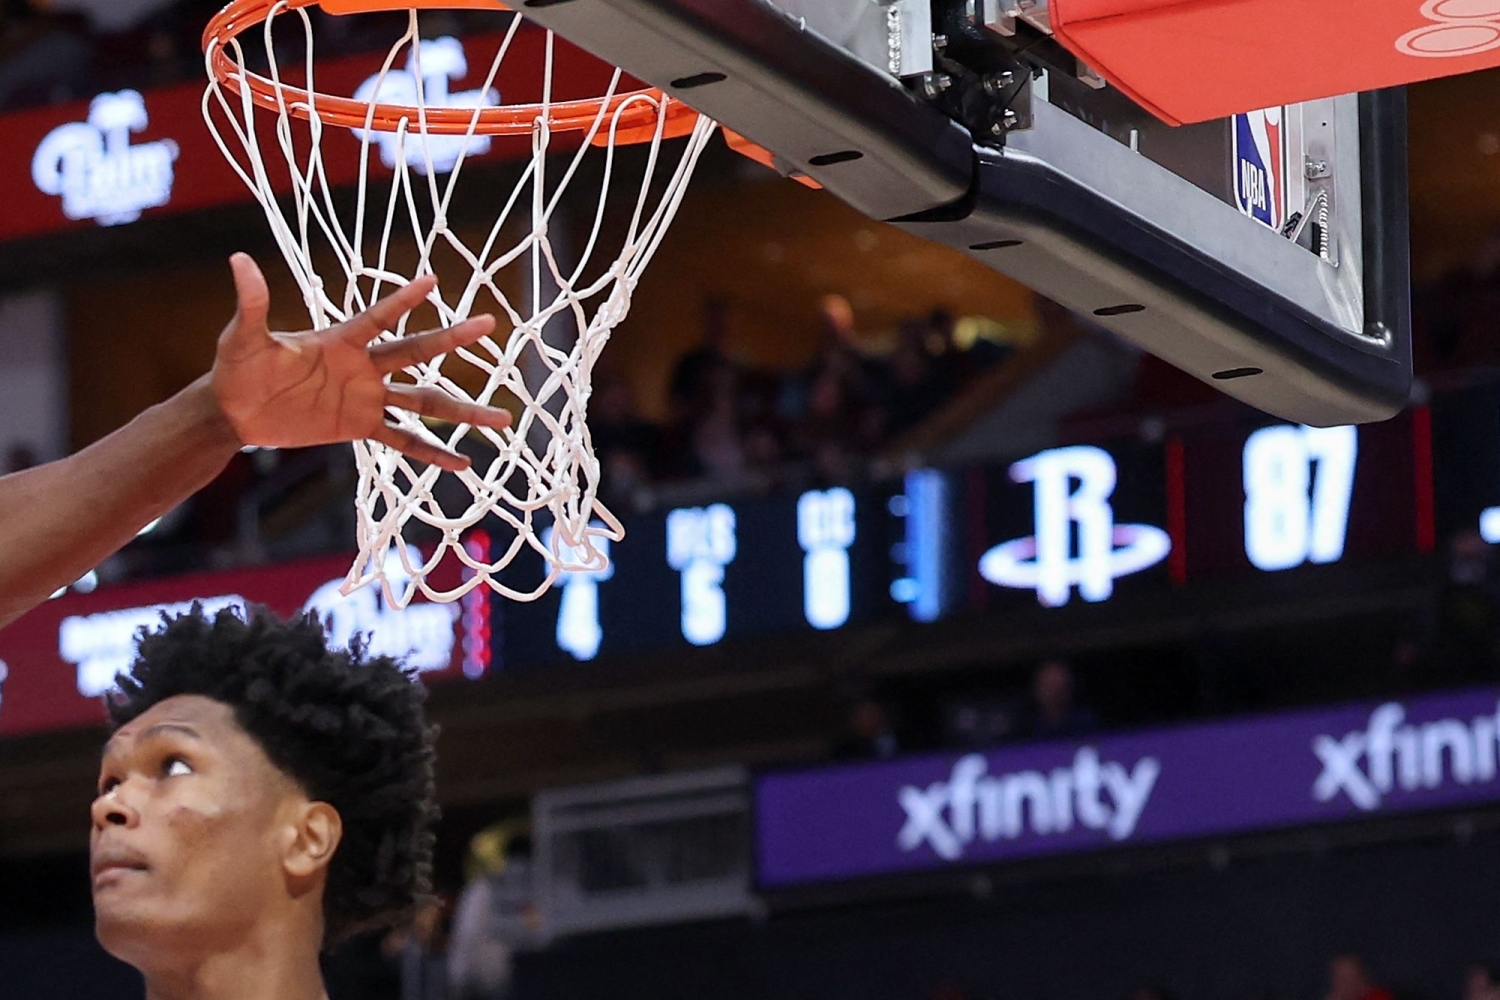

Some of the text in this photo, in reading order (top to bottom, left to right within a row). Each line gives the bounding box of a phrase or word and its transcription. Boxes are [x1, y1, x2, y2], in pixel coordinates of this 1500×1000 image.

[1241, 158, 1267, 212] NBA
[1242, 424, 1358, 571] 87
[897, 746, 1160, 859] xfinity
[1311, 701, 1500, 811] xfini
